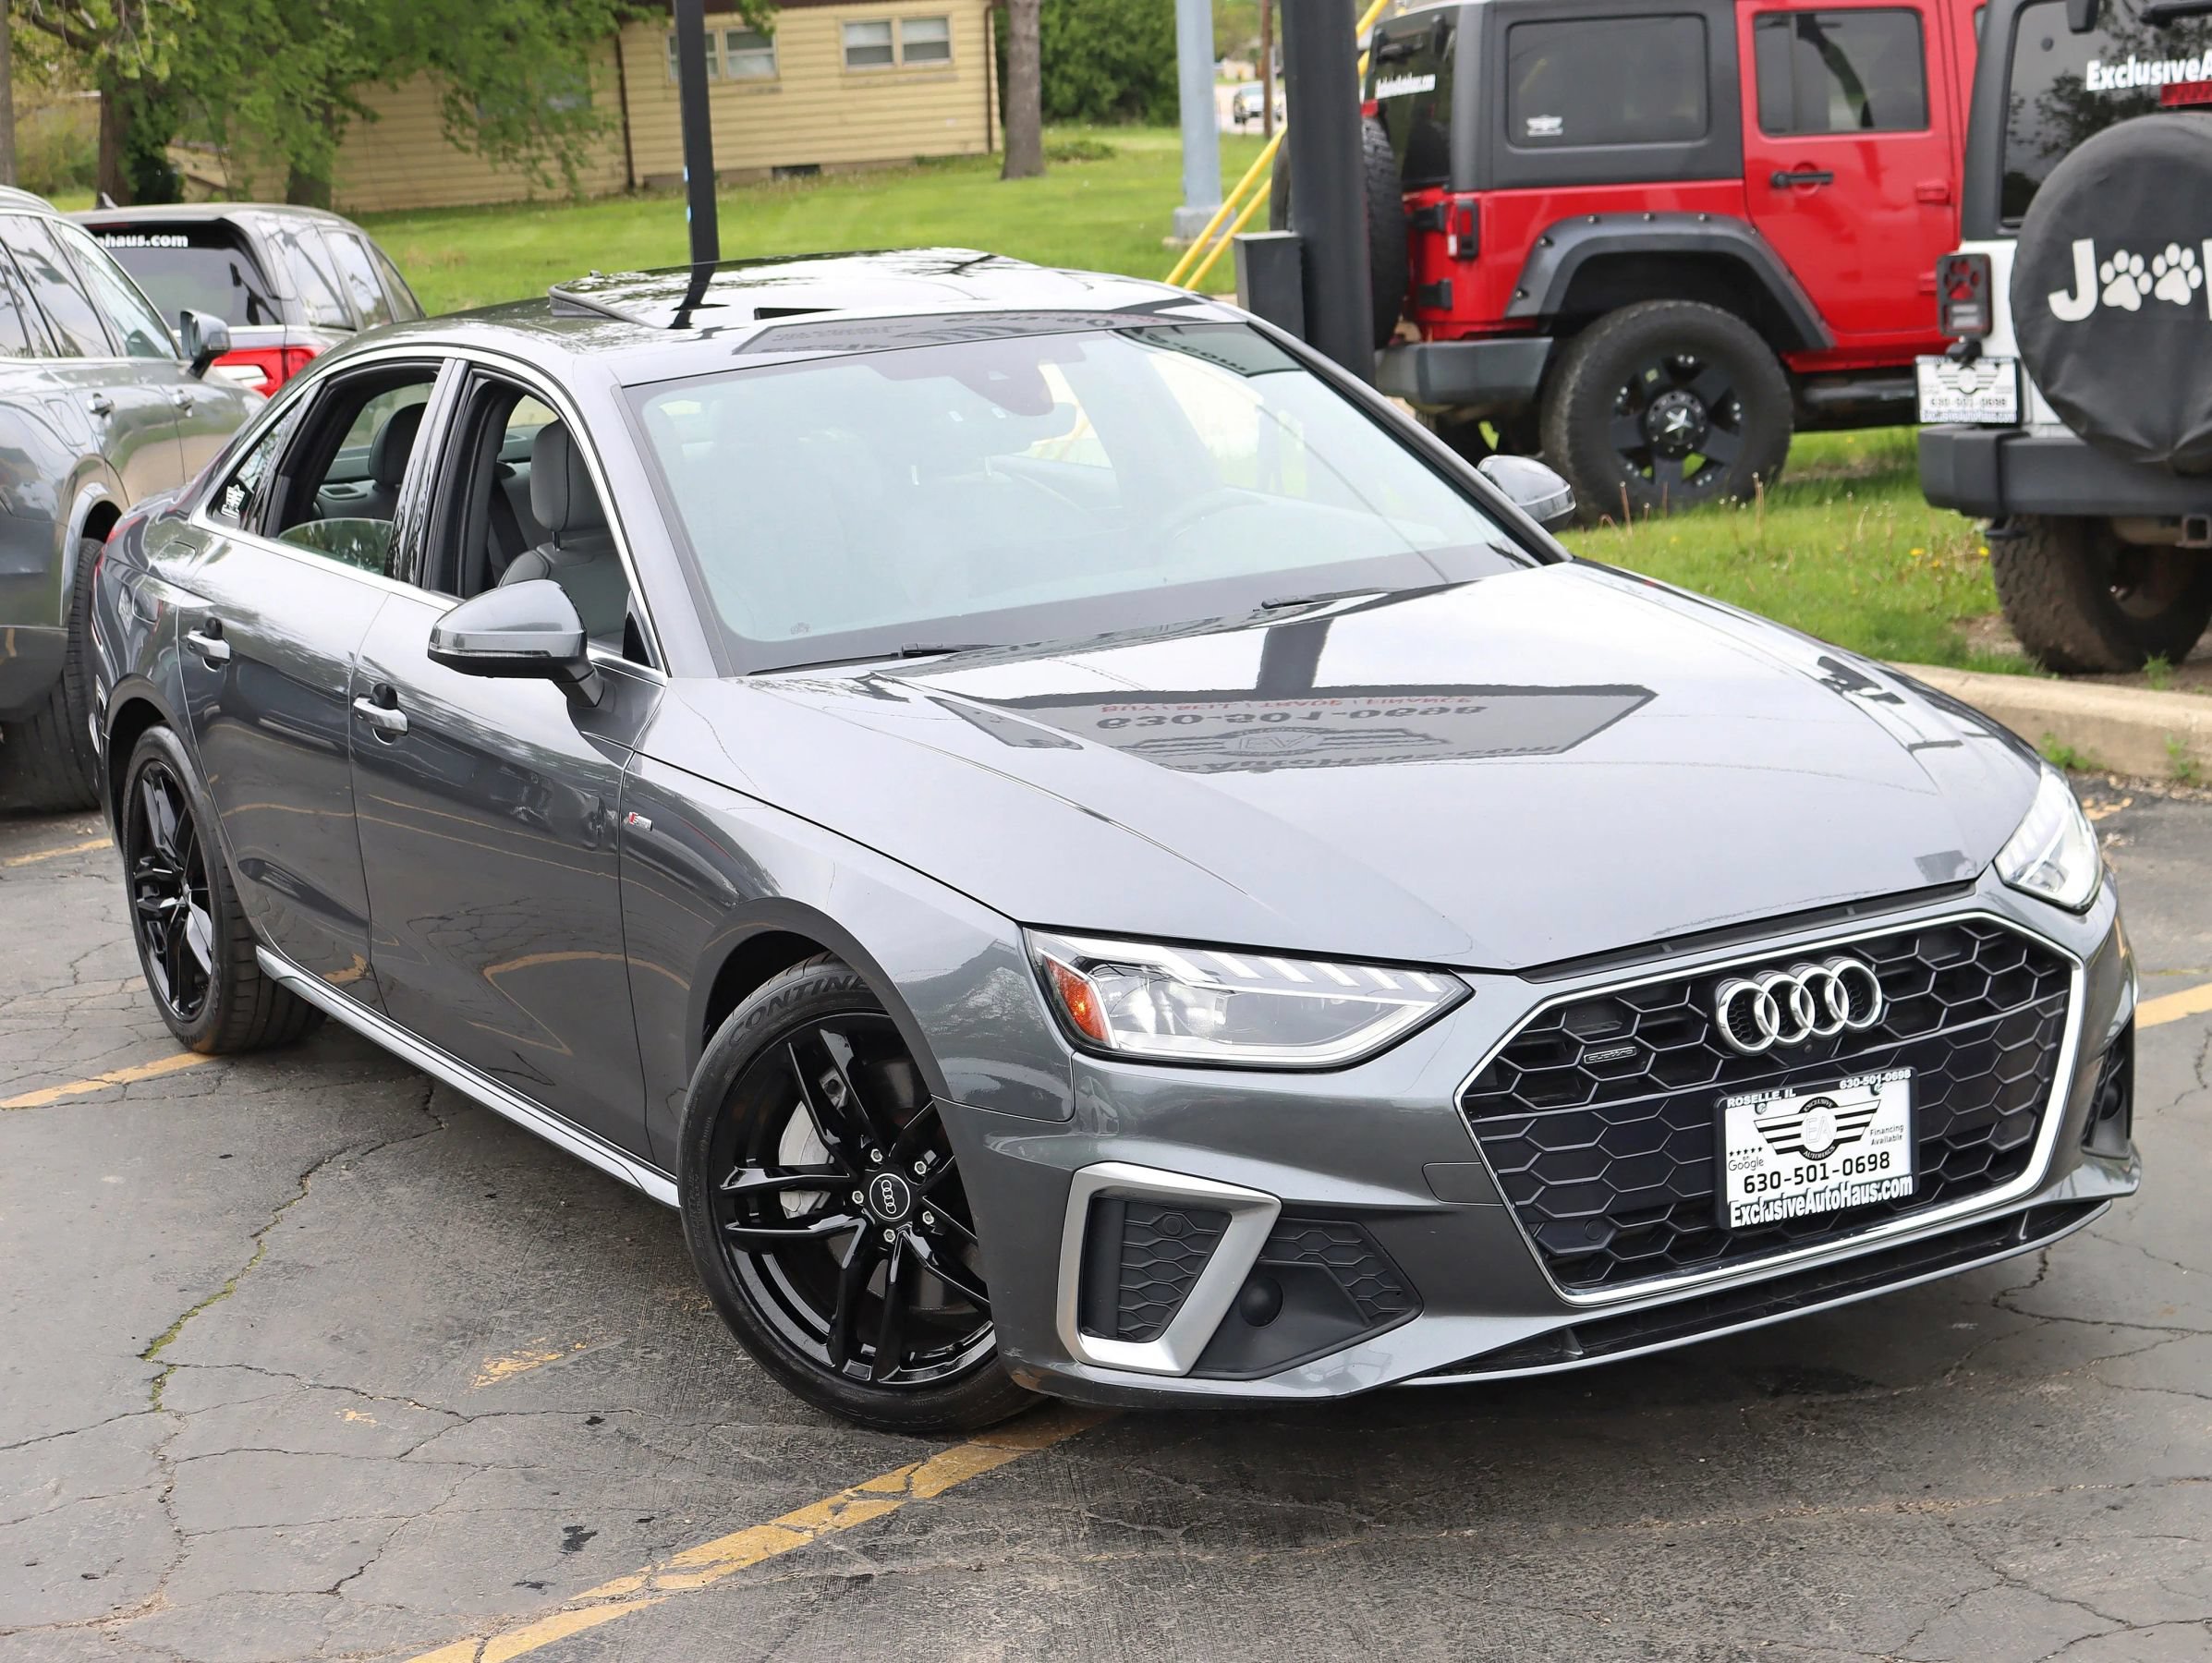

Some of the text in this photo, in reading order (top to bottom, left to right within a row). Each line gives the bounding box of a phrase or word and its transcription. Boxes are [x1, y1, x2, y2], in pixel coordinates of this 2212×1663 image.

[1839, 1069, 1912, 1089] 630-501-0698
[1727, 1088, 1796, 1109] ROSELLE, IL
[1869, 1124, 1904, 1136] Financing
[1728, 1157, 1764, 1171] Google
[1744, 1151, 1890, 1194] 630-501-0698
[1731, 1174, 1914, 1228] ExclusiveAutoHaus.com
